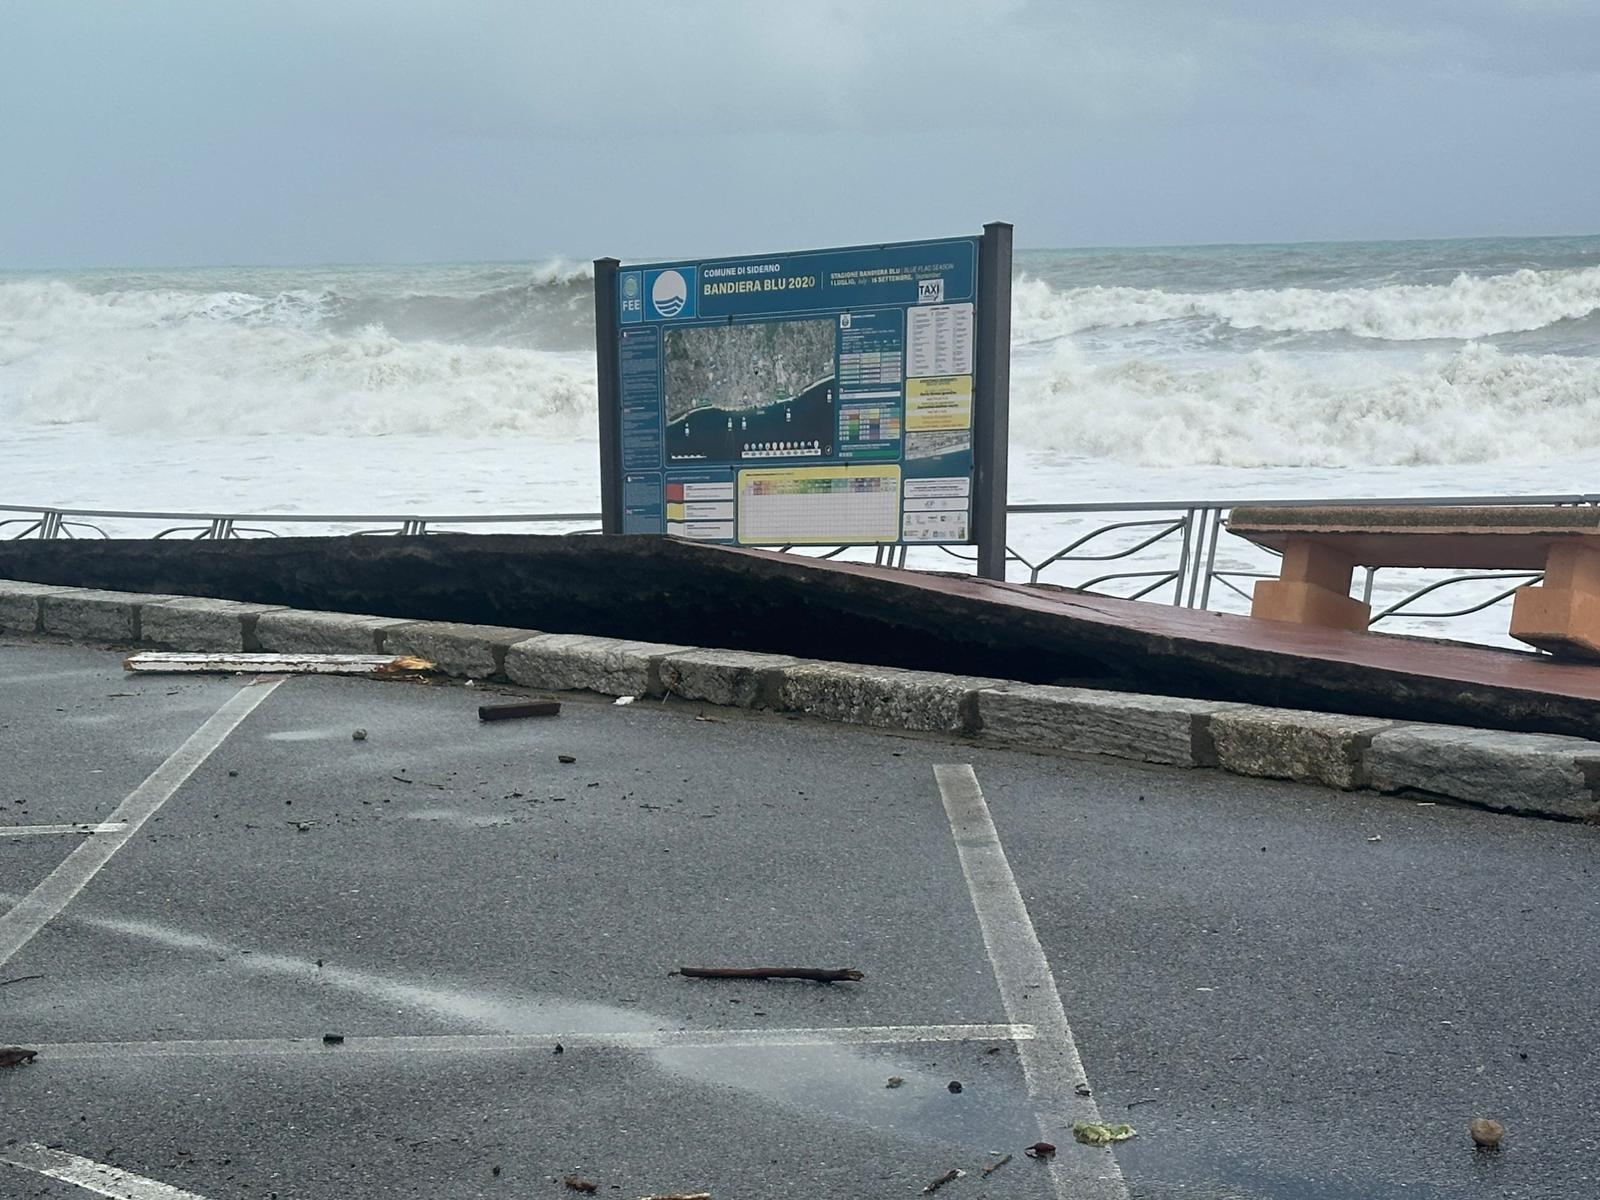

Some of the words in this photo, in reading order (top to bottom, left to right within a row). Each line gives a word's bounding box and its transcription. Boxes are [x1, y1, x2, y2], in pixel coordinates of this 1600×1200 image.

[704, 267, 736, 278] COMUNE
[737, 267, 745, 275] DI
[746, 264, 780, 274] SIDERNO
[704, 280, 761, 296] BANDIERA
[764, 278, 786, 291] BLU
[788, 276, 816, 289] 2020
[918, 284, 940, 295] TAXI
[622, 299, 640, 311] FEE
